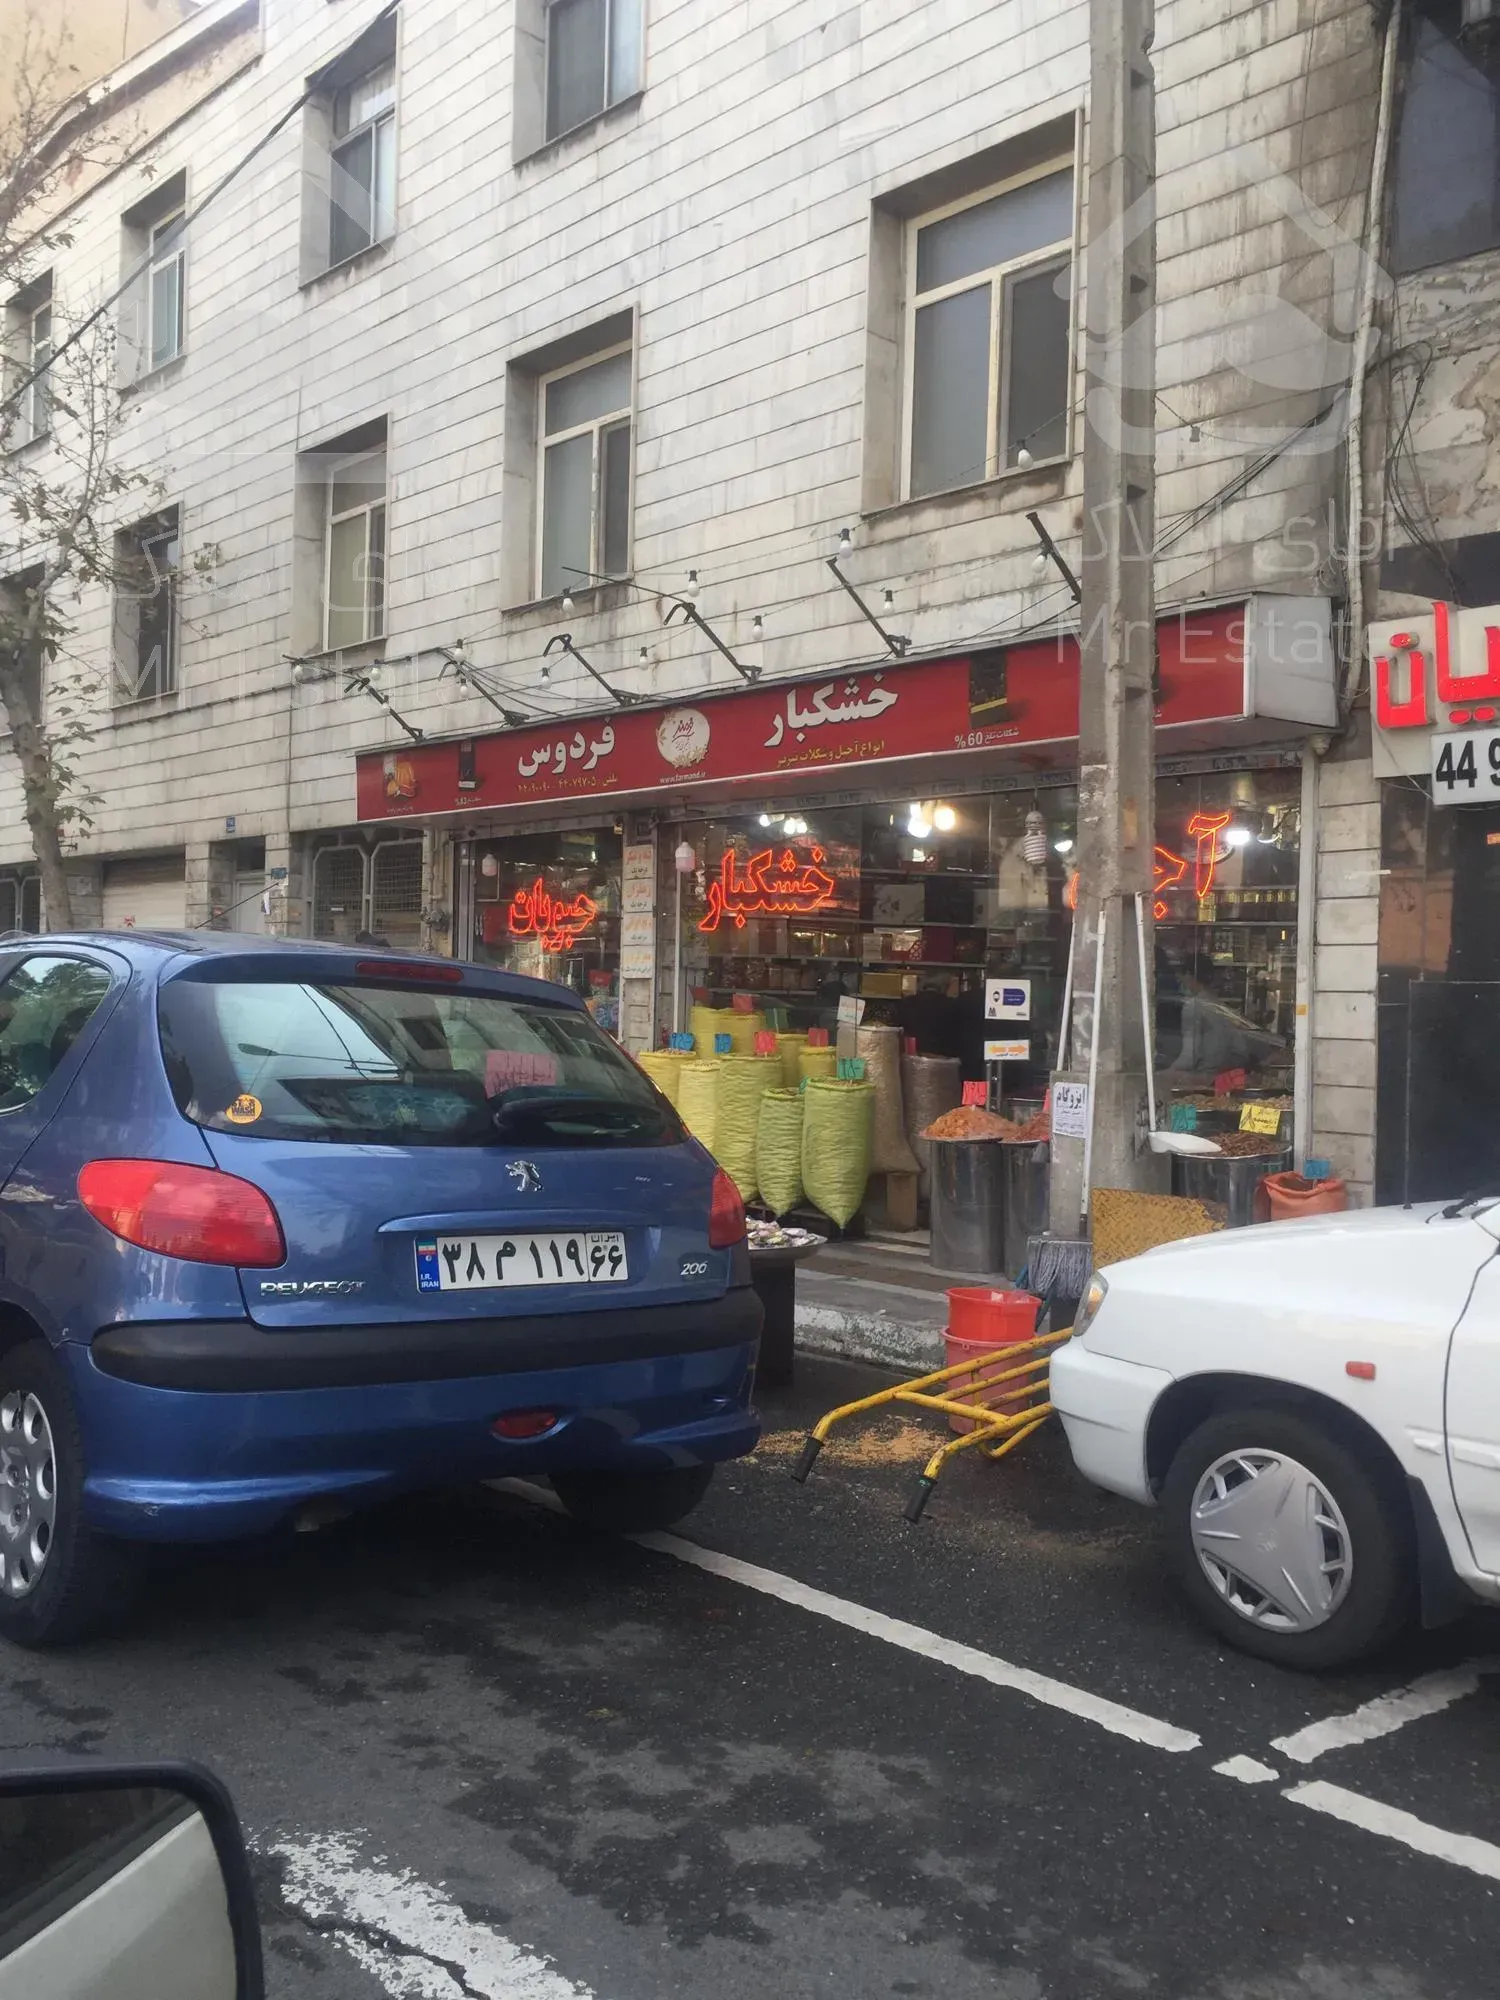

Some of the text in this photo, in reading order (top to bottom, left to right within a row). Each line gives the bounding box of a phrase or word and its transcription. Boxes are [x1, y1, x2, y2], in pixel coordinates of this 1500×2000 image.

[763, 673, 899, 747] خشکبار
[517, 716, 615, 777] فردوس
[509, 877, 597, 951] حبوبات
[697, 846, 835, 932] خشکبار
[442, 1239, 623, 1283] ۳۸ م ۱۱۹ ۶۶
[590, 1233, 620, 1243] ایران
[260, 1281, 366, 1296] PEUGEOT
[680, 1261, 708, 1275] 206
